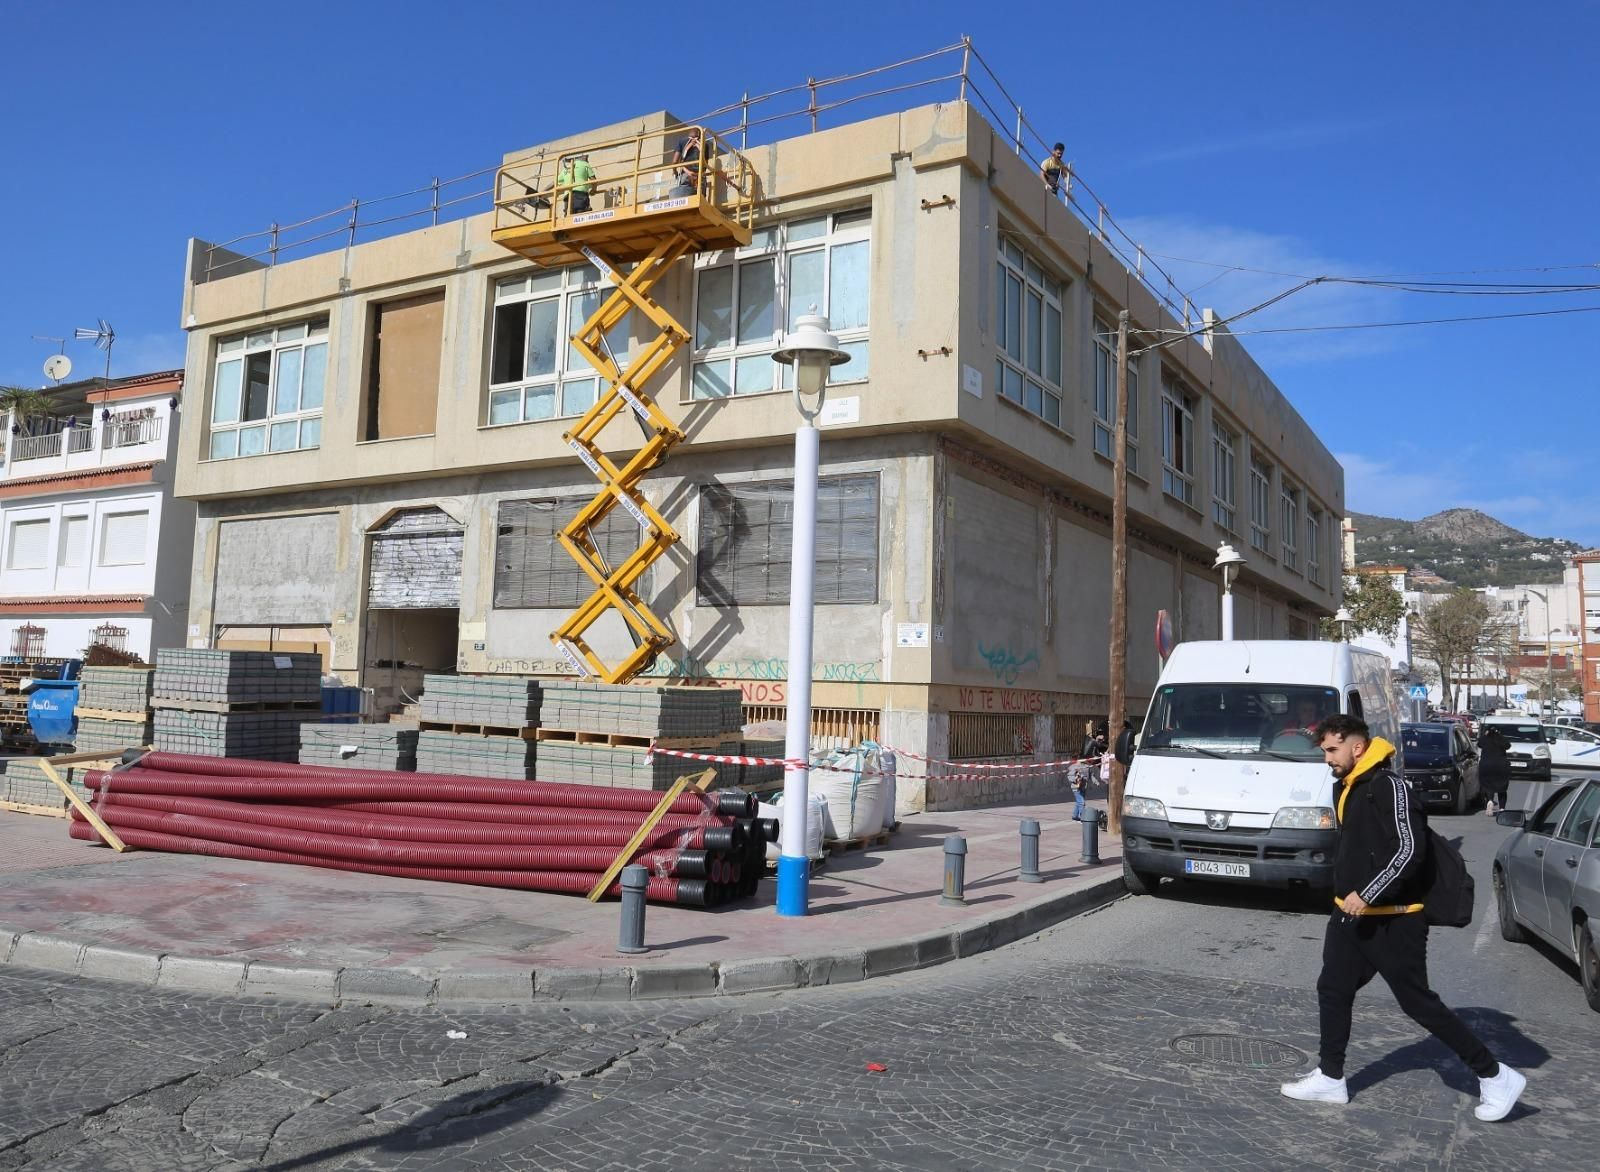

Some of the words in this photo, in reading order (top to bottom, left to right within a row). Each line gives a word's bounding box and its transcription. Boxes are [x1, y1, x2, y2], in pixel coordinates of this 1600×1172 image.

[959, 688, 974, 708] NO
[980, 690, 993, 709] TE
[1001, 690, 1042, 713] VACUNES
[1193, 862, 1219, 873] 8043
[1225, 864, 1245, 875] DVR
